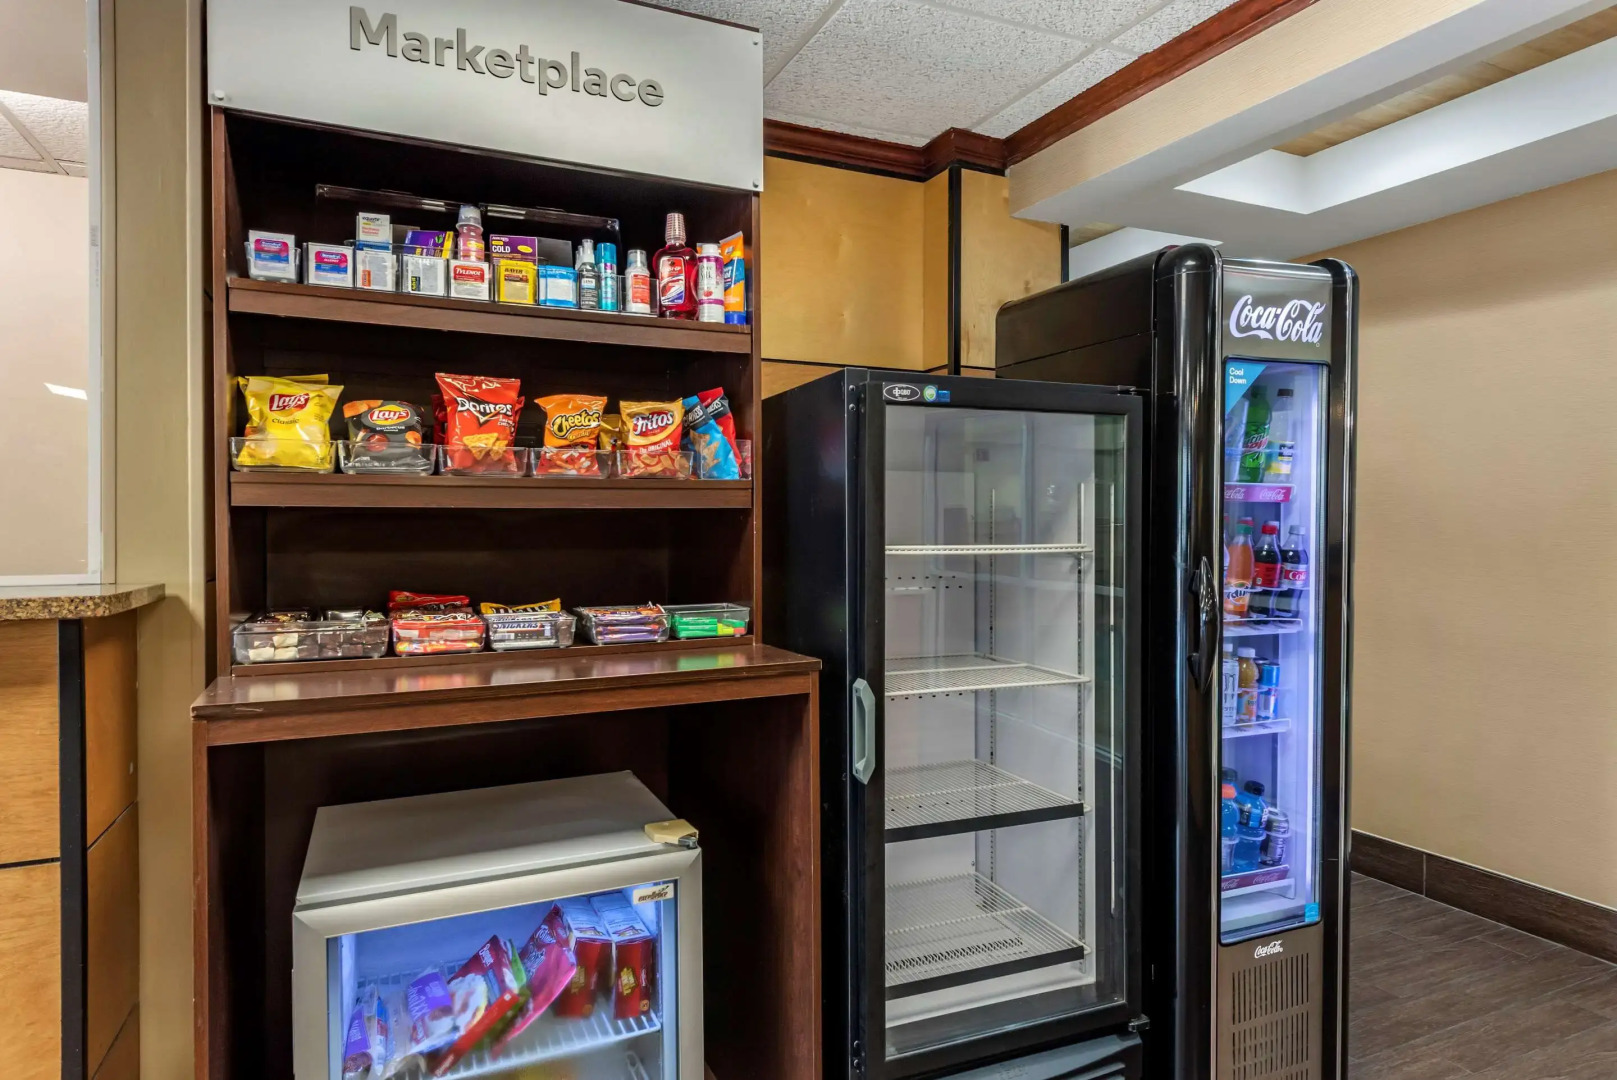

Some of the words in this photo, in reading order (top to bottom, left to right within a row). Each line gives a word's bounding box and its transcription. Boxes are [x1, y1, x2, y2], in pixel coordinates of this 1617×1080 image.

[348, 6, 665, 107] Marketplace
[492, 245, 511, 253] COLD
[455, 267, 481, 276] TYLENOL
[1229, 294, 1326, 344] Coca-Cola
[1229, 367, 1244, 376] Cool
[1229, 376, 1247, 385] Down
[457, 397, 513, 416] Doritos
[271, 417, 300, 425] Classic
[552, 411, 601, 438] Cheetos
[633, 411, 675, 435] Fritos
[496, 622, 539, 630] SNICKERS
[1254, 940, 1284, 959] Coca-Cola
